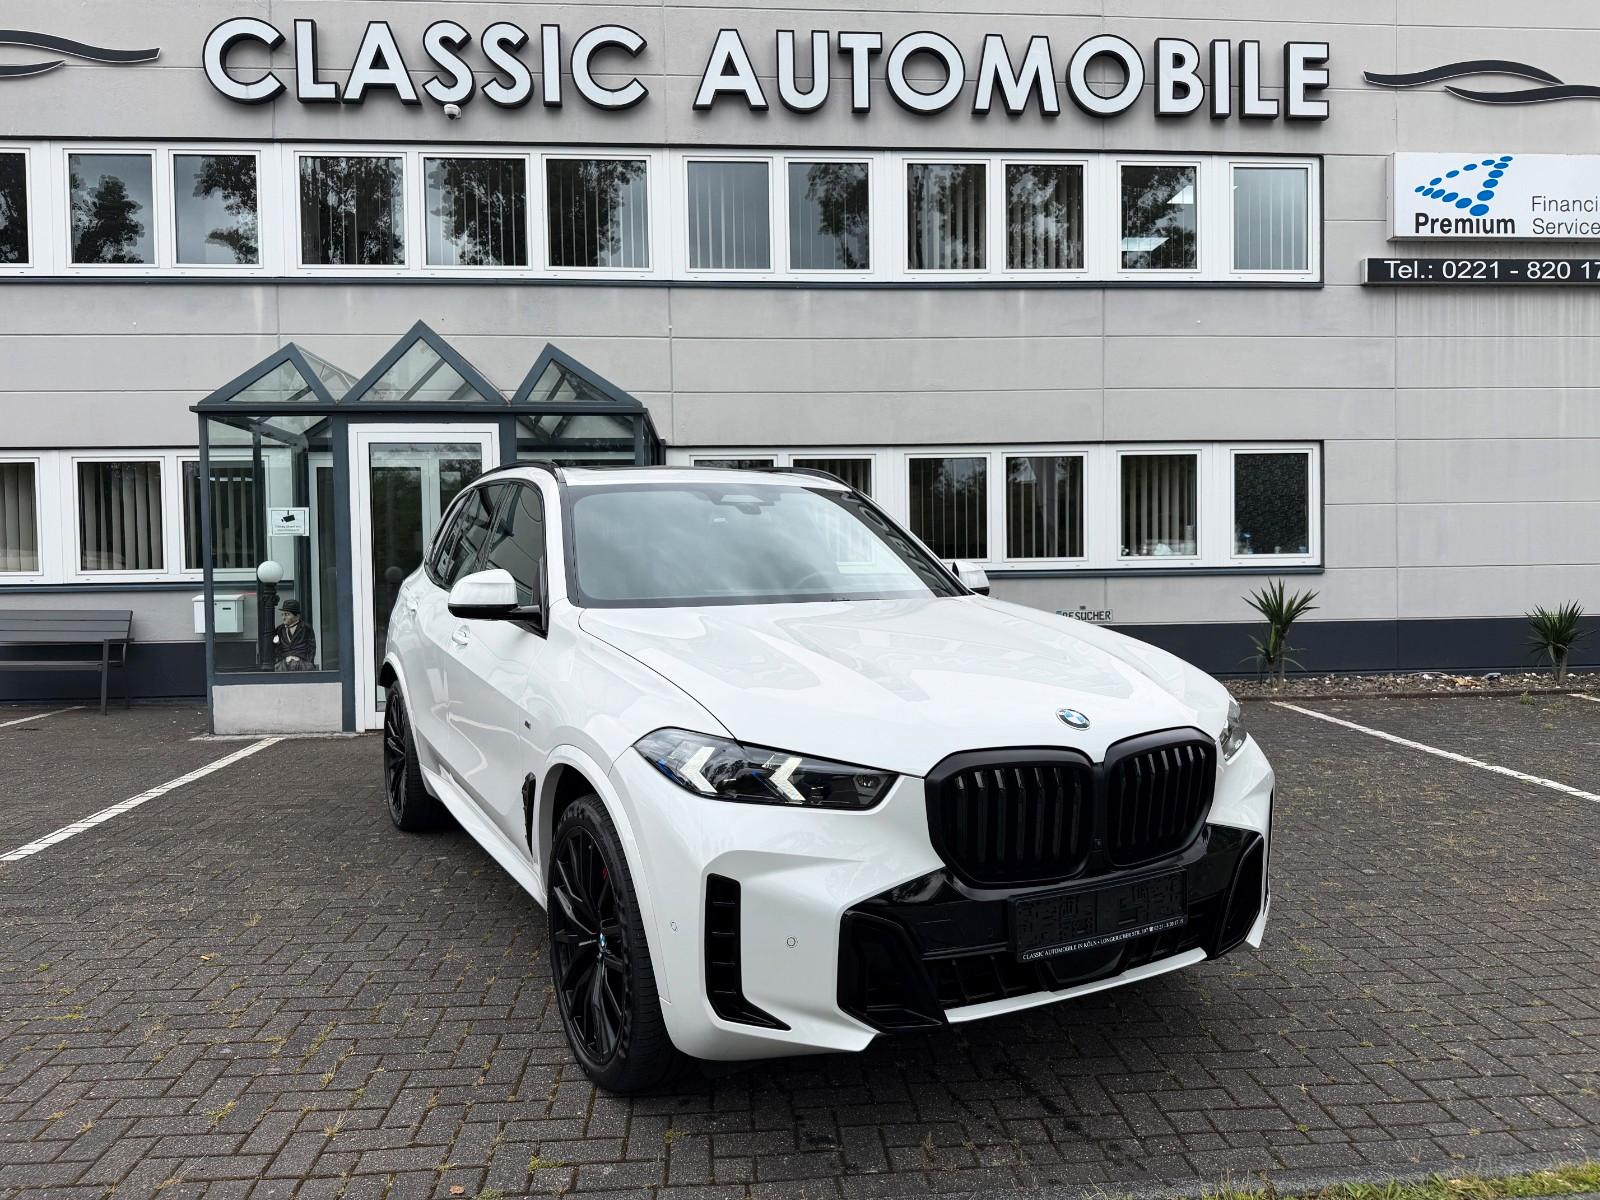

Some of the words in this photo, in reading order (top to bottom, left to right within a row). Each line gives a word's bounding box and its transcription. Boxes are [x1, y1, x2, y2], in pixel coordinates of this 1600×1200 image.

[202, 16, 649, 111] CLASSIC
[692, 28, 1331, 120] AUTOMOBILE
[1531, 195, 1599, 212] Financi
[1415, 212, 1516, 234] Premium
[1532, 217, 1600, 235] Service
[1383, 260, 1433, 279] Tel.:
[1442, 260, 1499, 279] 0221
[1526, 261, 1571, 280] 820
[1022, 951, 1045, 960] CLASSIC
